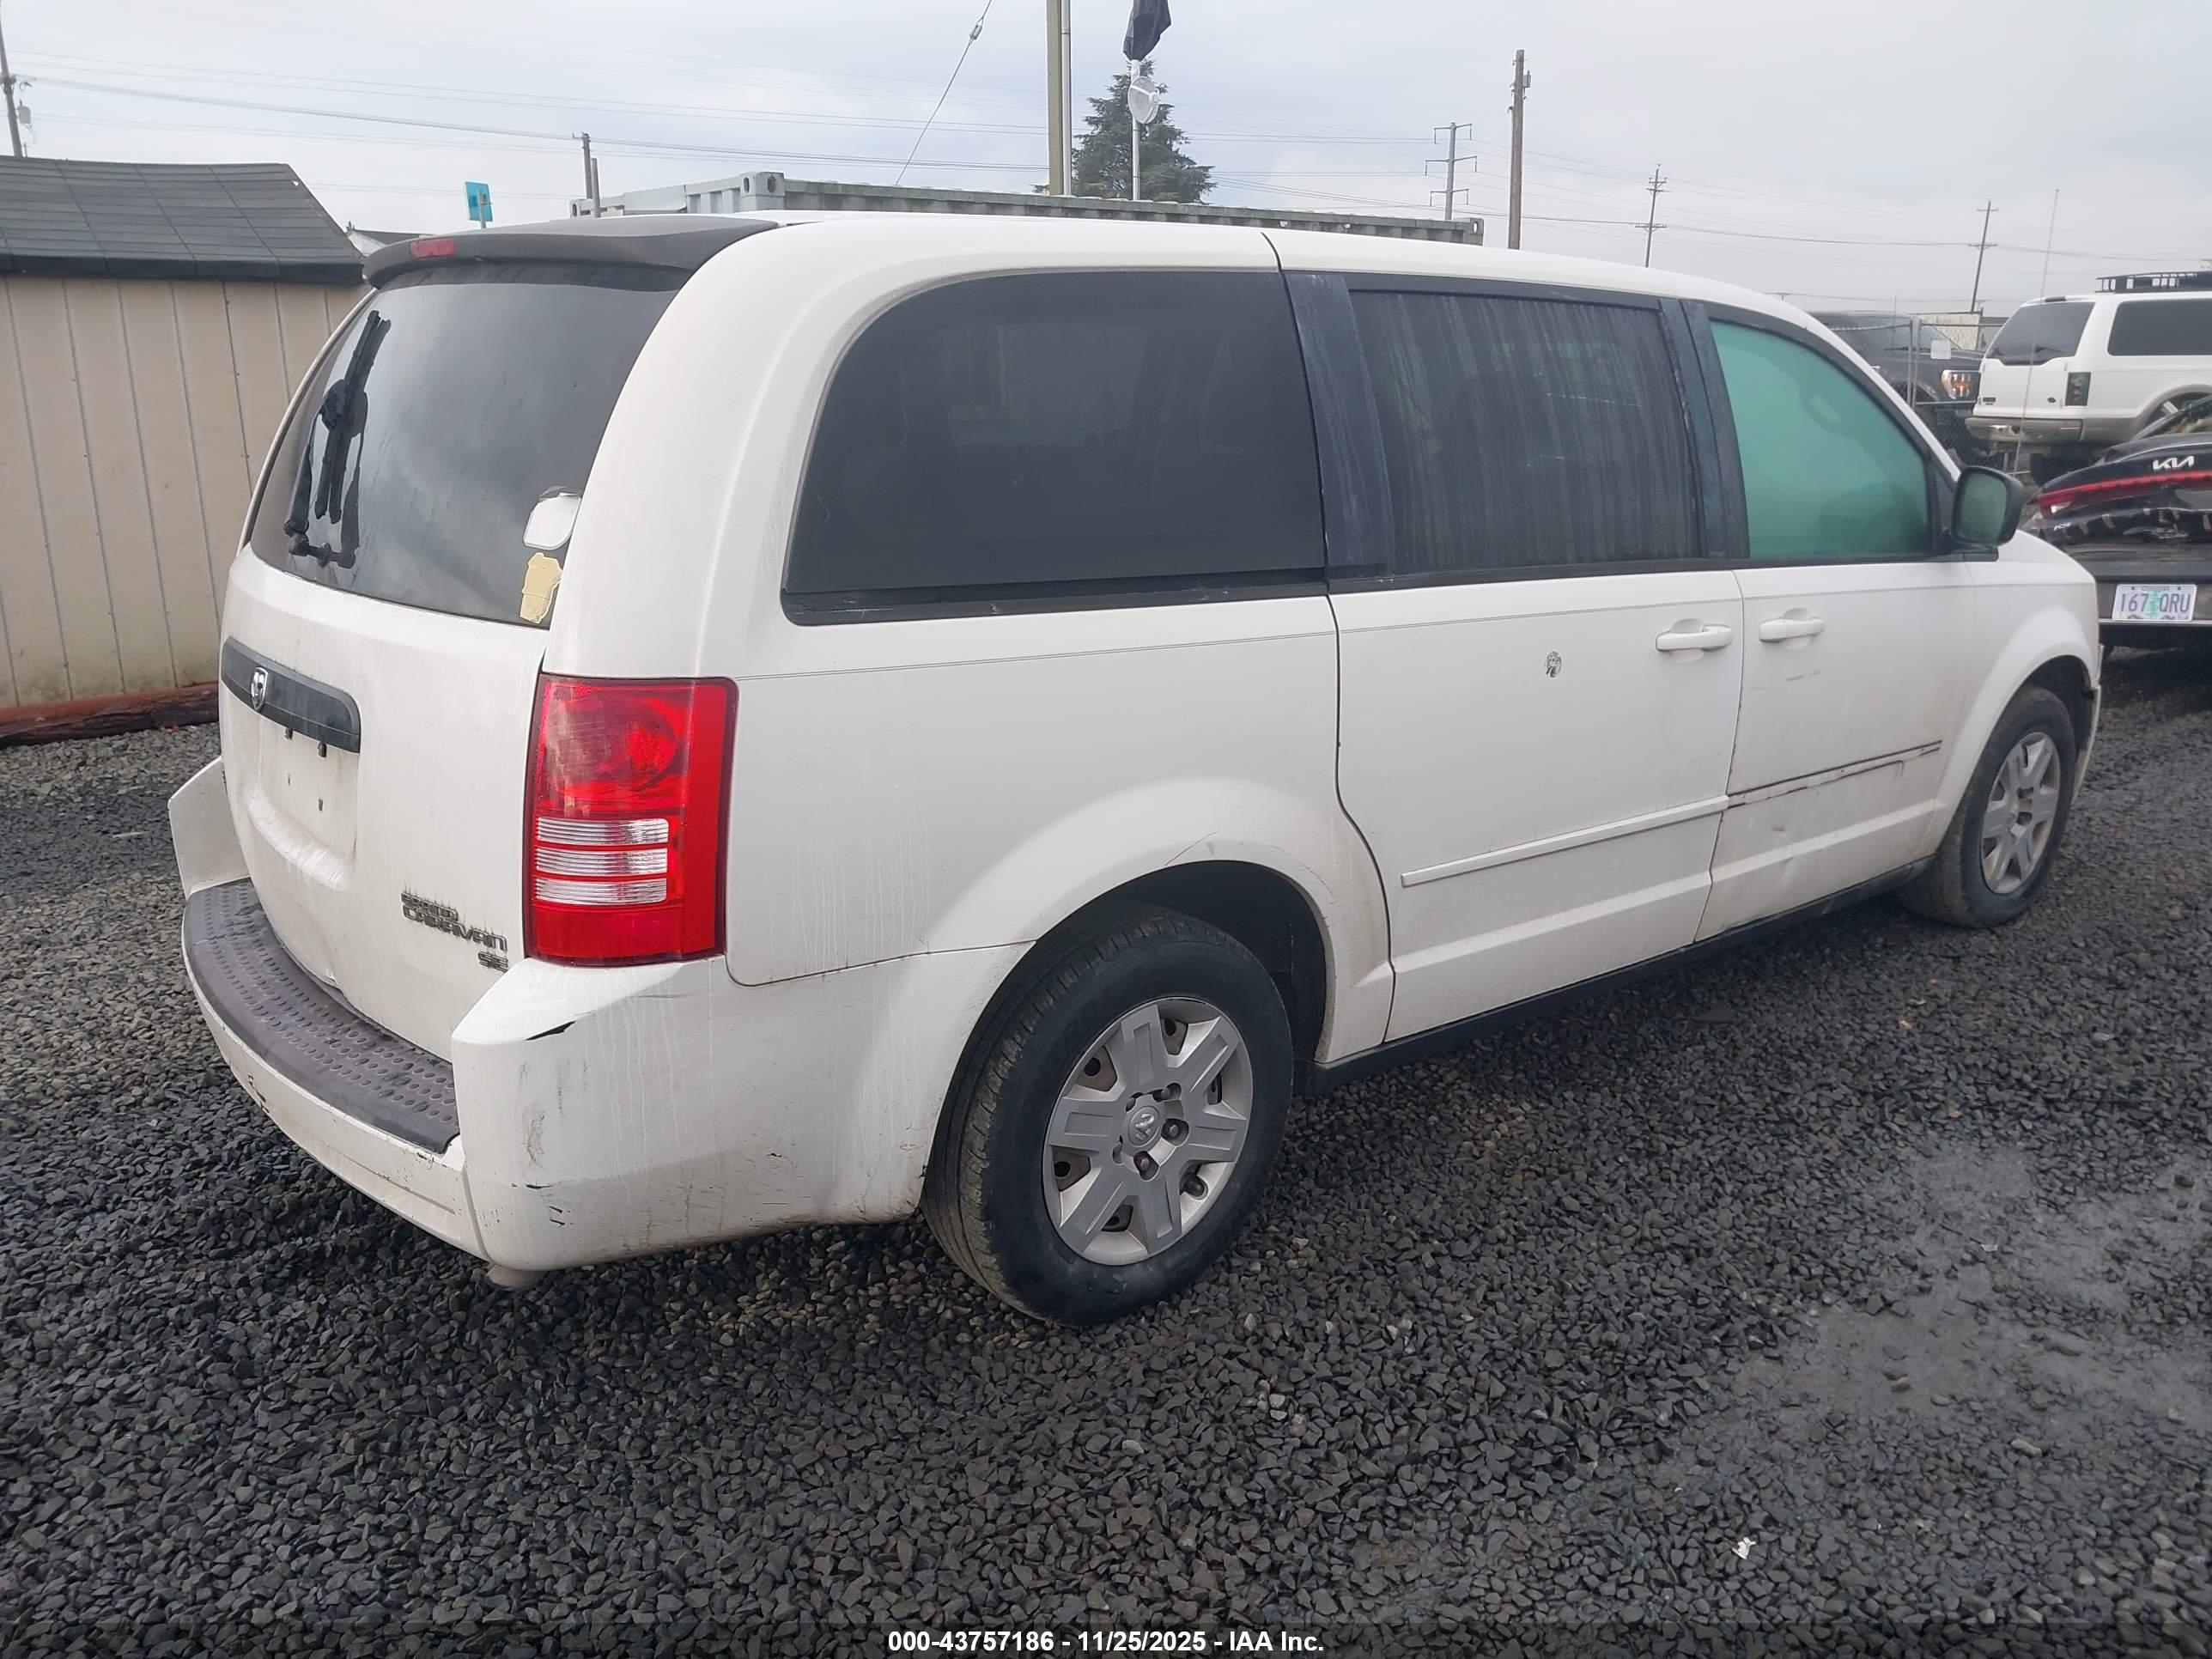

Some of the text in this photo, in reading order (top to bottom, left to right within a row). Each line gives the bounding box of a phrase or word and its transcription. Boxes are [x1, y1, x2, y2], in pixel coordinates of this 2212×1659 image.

[2153, 456, 2195, 470] KIA
[2121, 593, 2191, 613] 167 QRU
[403, 904, 507, 953] CARAVAN
